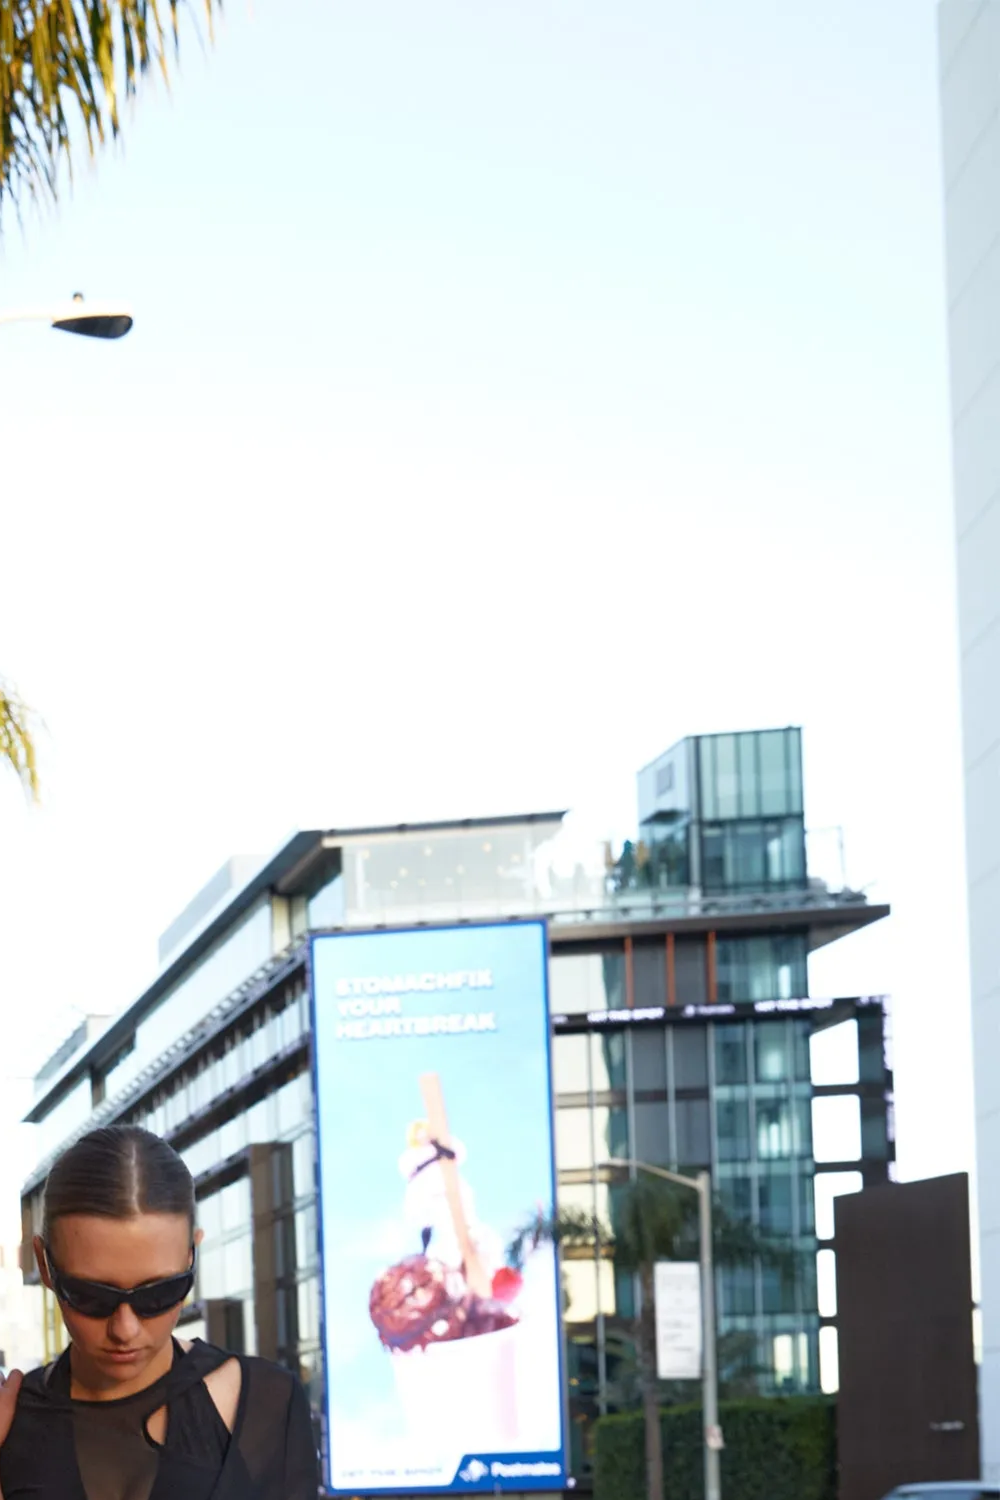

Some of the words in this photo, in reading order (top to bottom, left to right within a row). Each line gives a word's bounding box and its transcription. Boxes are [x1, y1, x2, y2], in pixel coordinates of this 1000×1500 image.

[337, 997, 401, 1016] YOUR
[336, 1012, 496, 1039] HEARTBREAK
[491, 1461, 562, 1477] Postmates
